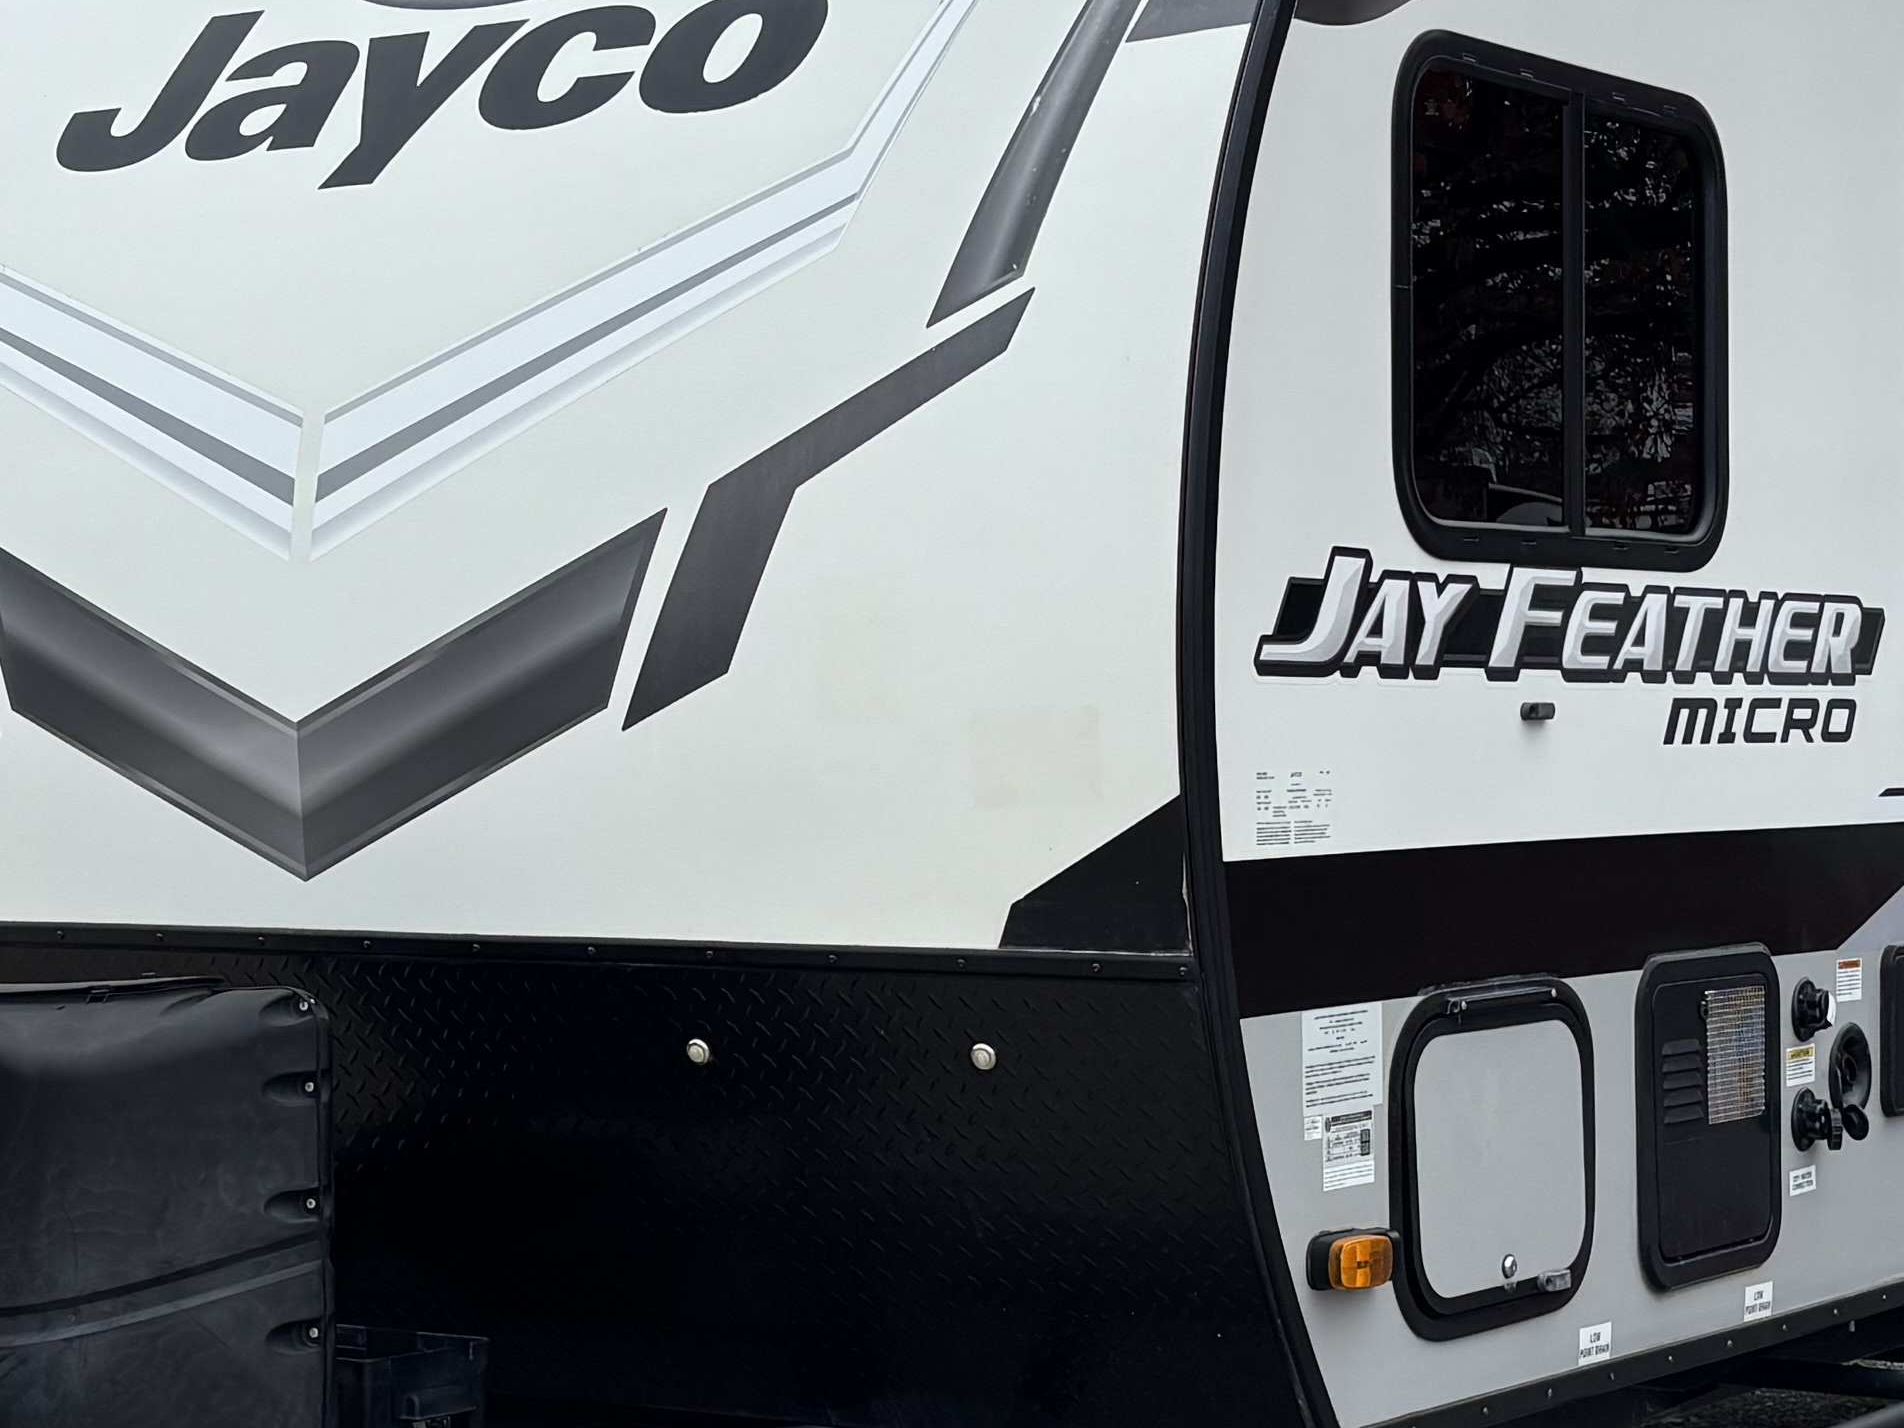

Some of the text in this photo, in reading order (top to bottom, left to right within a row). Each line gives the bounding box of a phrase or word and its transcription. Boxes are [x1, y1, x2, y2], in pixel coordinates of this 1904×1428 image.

[1254, 546, 1864, 686] JAY FEATHER
[1662, 697, 1857, 745] MICRO
